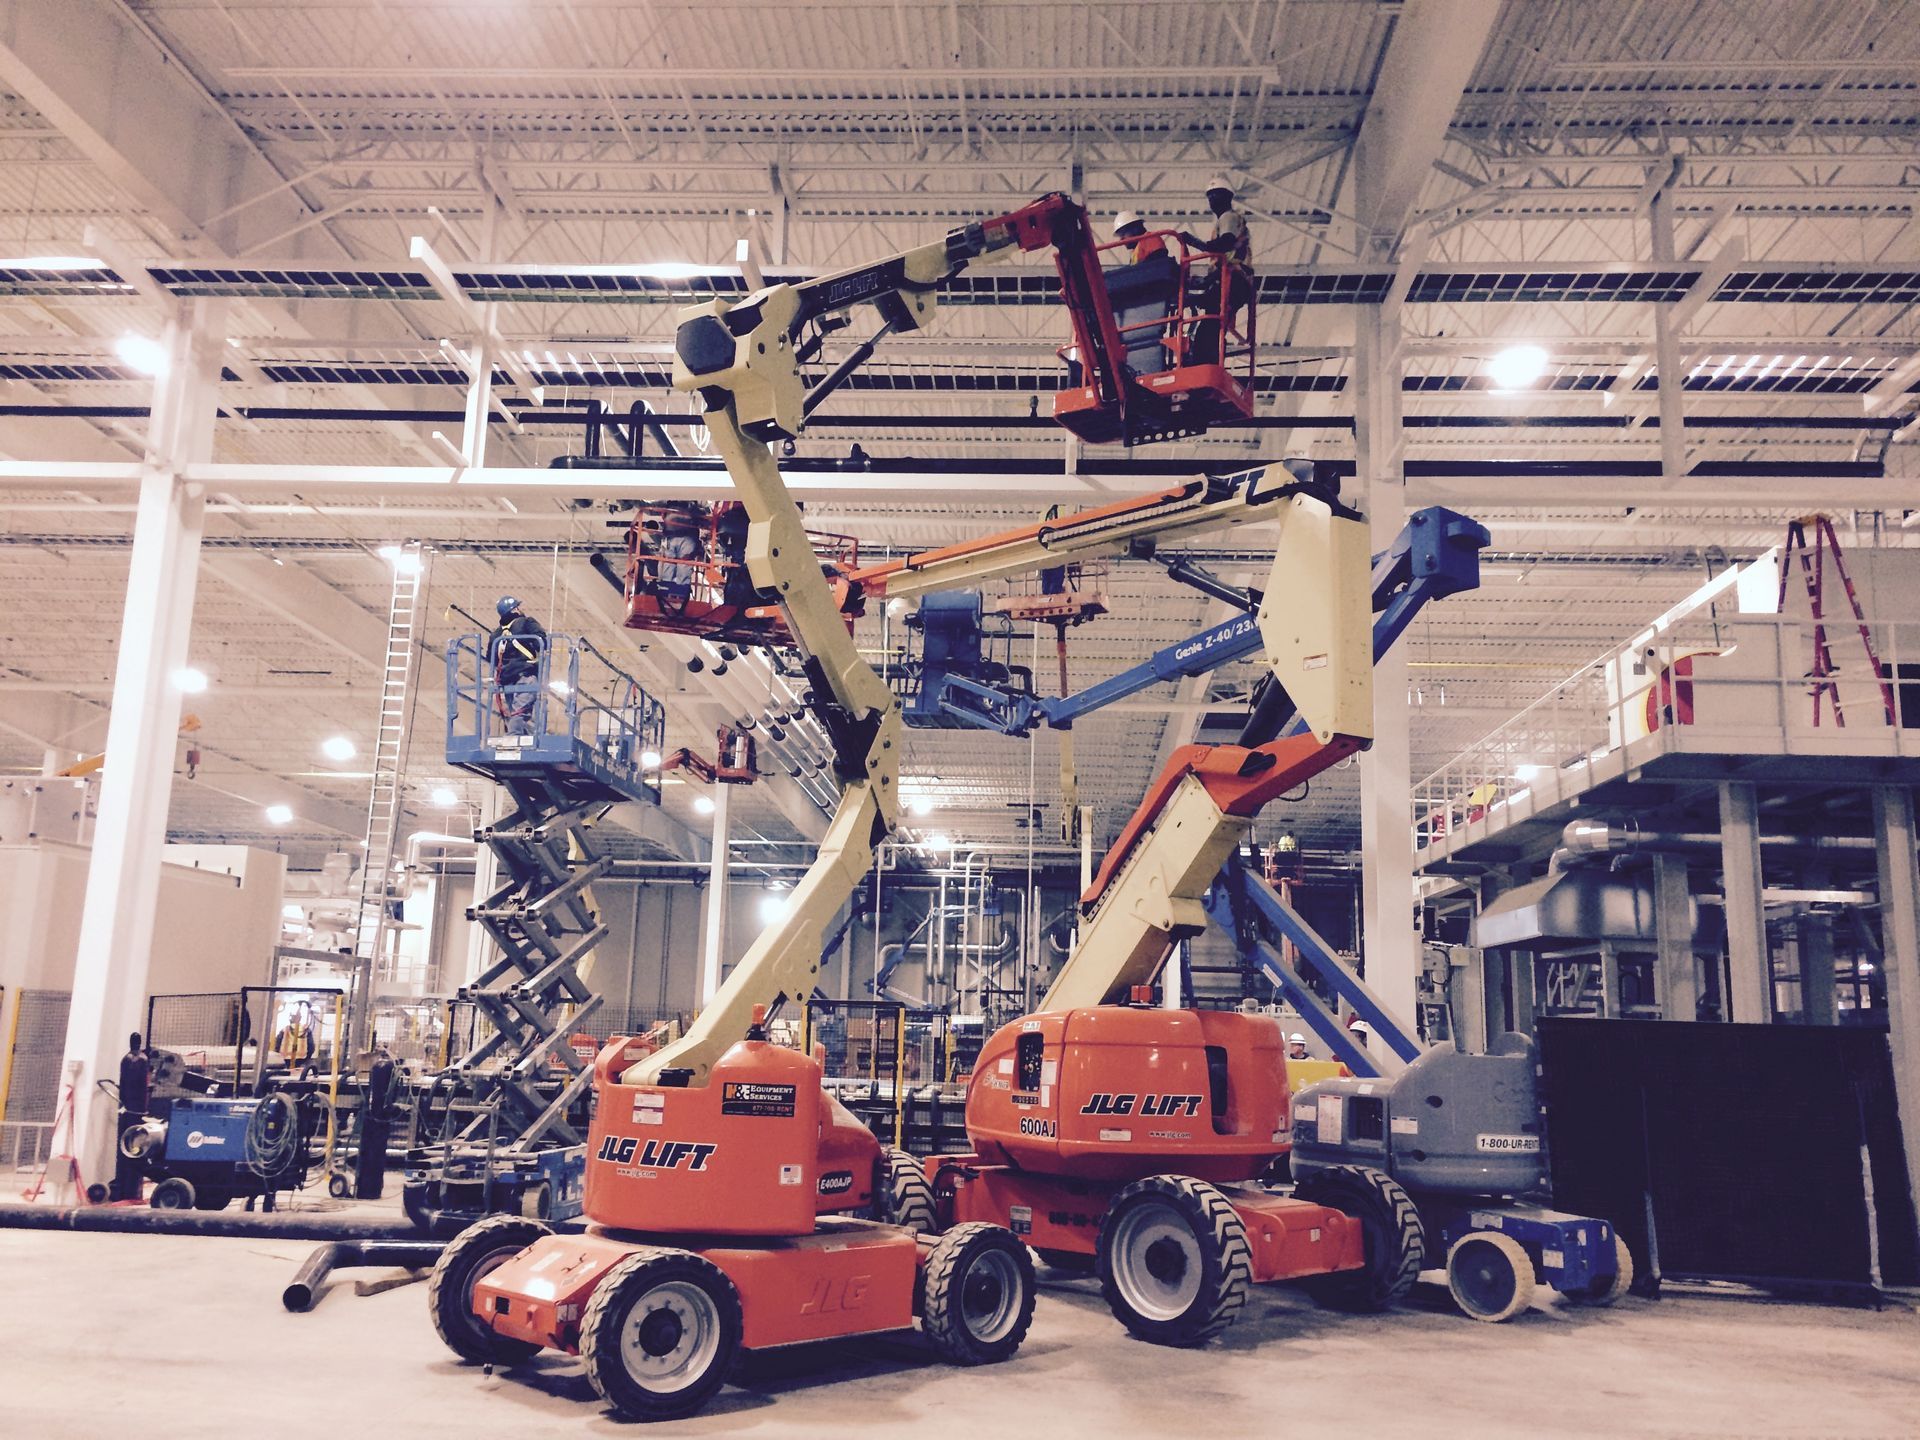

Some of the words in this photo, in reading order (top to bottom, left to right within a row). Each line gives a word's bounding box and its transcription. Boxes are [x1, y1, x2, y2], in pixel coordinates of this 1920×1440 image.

[829, 280, 851, 303] JLG
[853, 272, 878, 295] LIFT
[1175, 642, 1204, 660] Genie
[725, 1083, 751, 1100] H&E
[1080, 1093, 1138, 1116] JLG
[1139, 1094, 1204, 1117] LIFT
[1020, 1117, 1057, 1138] 600AJ
[597, 1135, 640, 1165] JLG
[638, 1139, 718, 1171] LIFT
[820, 1176, 852, 1190] E400AJP
